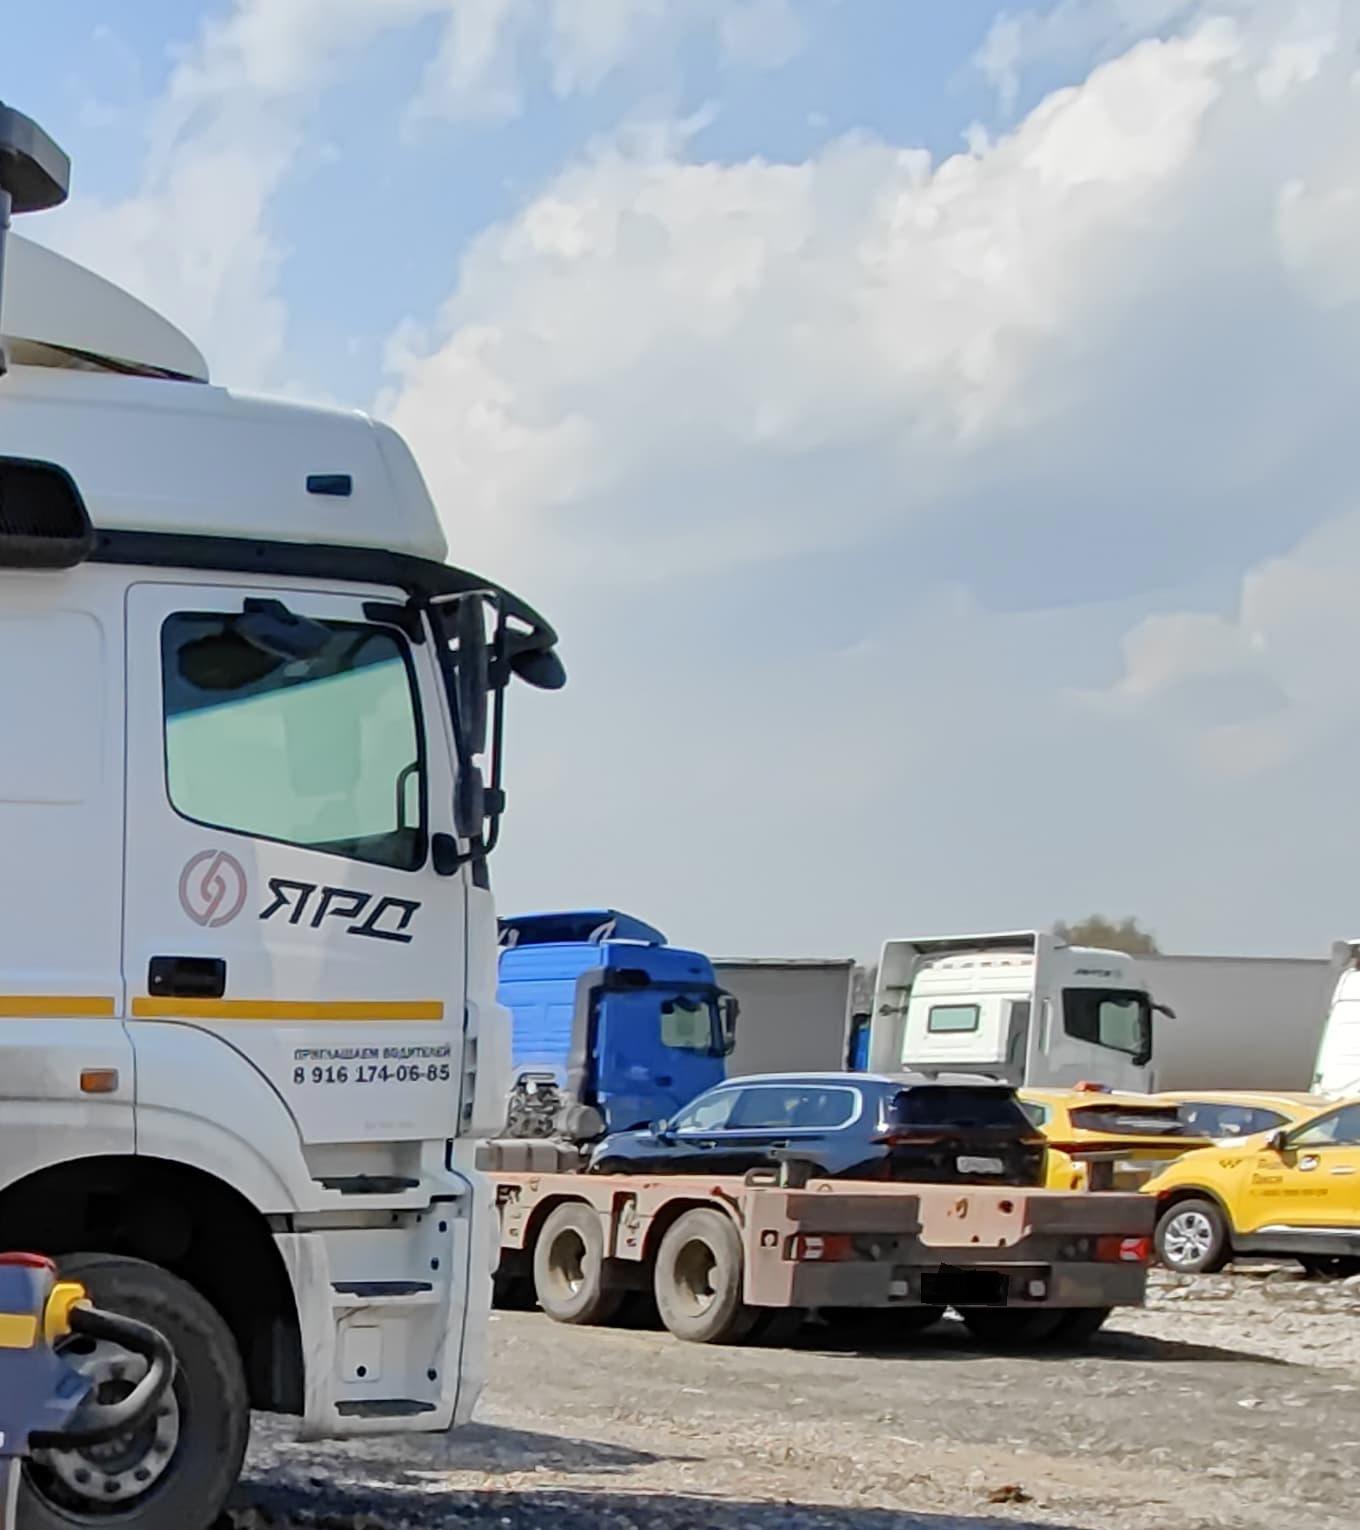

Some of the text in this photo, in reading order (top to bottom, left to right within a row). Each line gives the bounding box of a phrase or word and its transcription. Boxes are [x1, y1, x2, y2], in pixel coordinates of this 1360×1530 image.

[259, 877, 421, 943] ЯРД
[293, 1064, 450, 1084] 8 916 174-06-85
